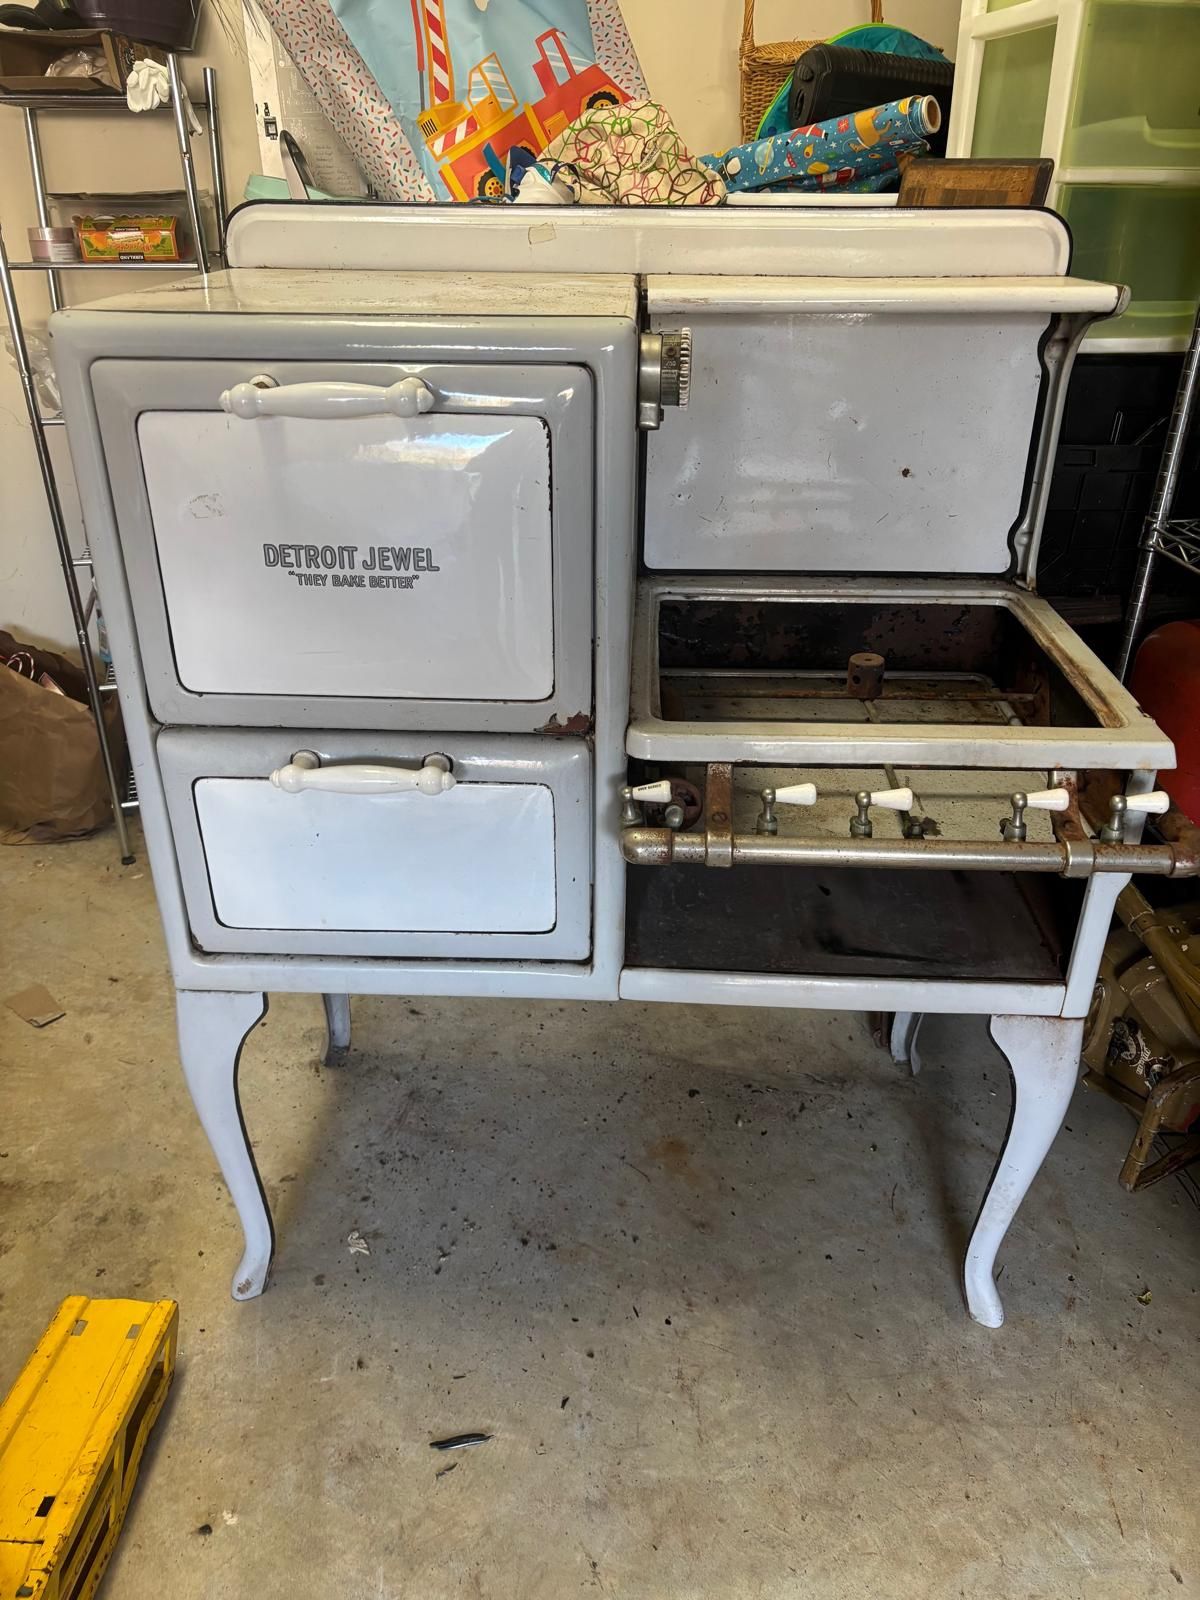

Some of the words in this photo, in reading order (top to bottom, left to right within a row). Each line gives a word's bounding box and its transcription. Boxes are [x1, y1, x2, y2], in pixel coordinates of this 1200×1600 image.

[263, 543, 358, 569] DETROIT
[362, 546, 440, 572] JEWEL
[332, 574, 366, 588] BAKE
